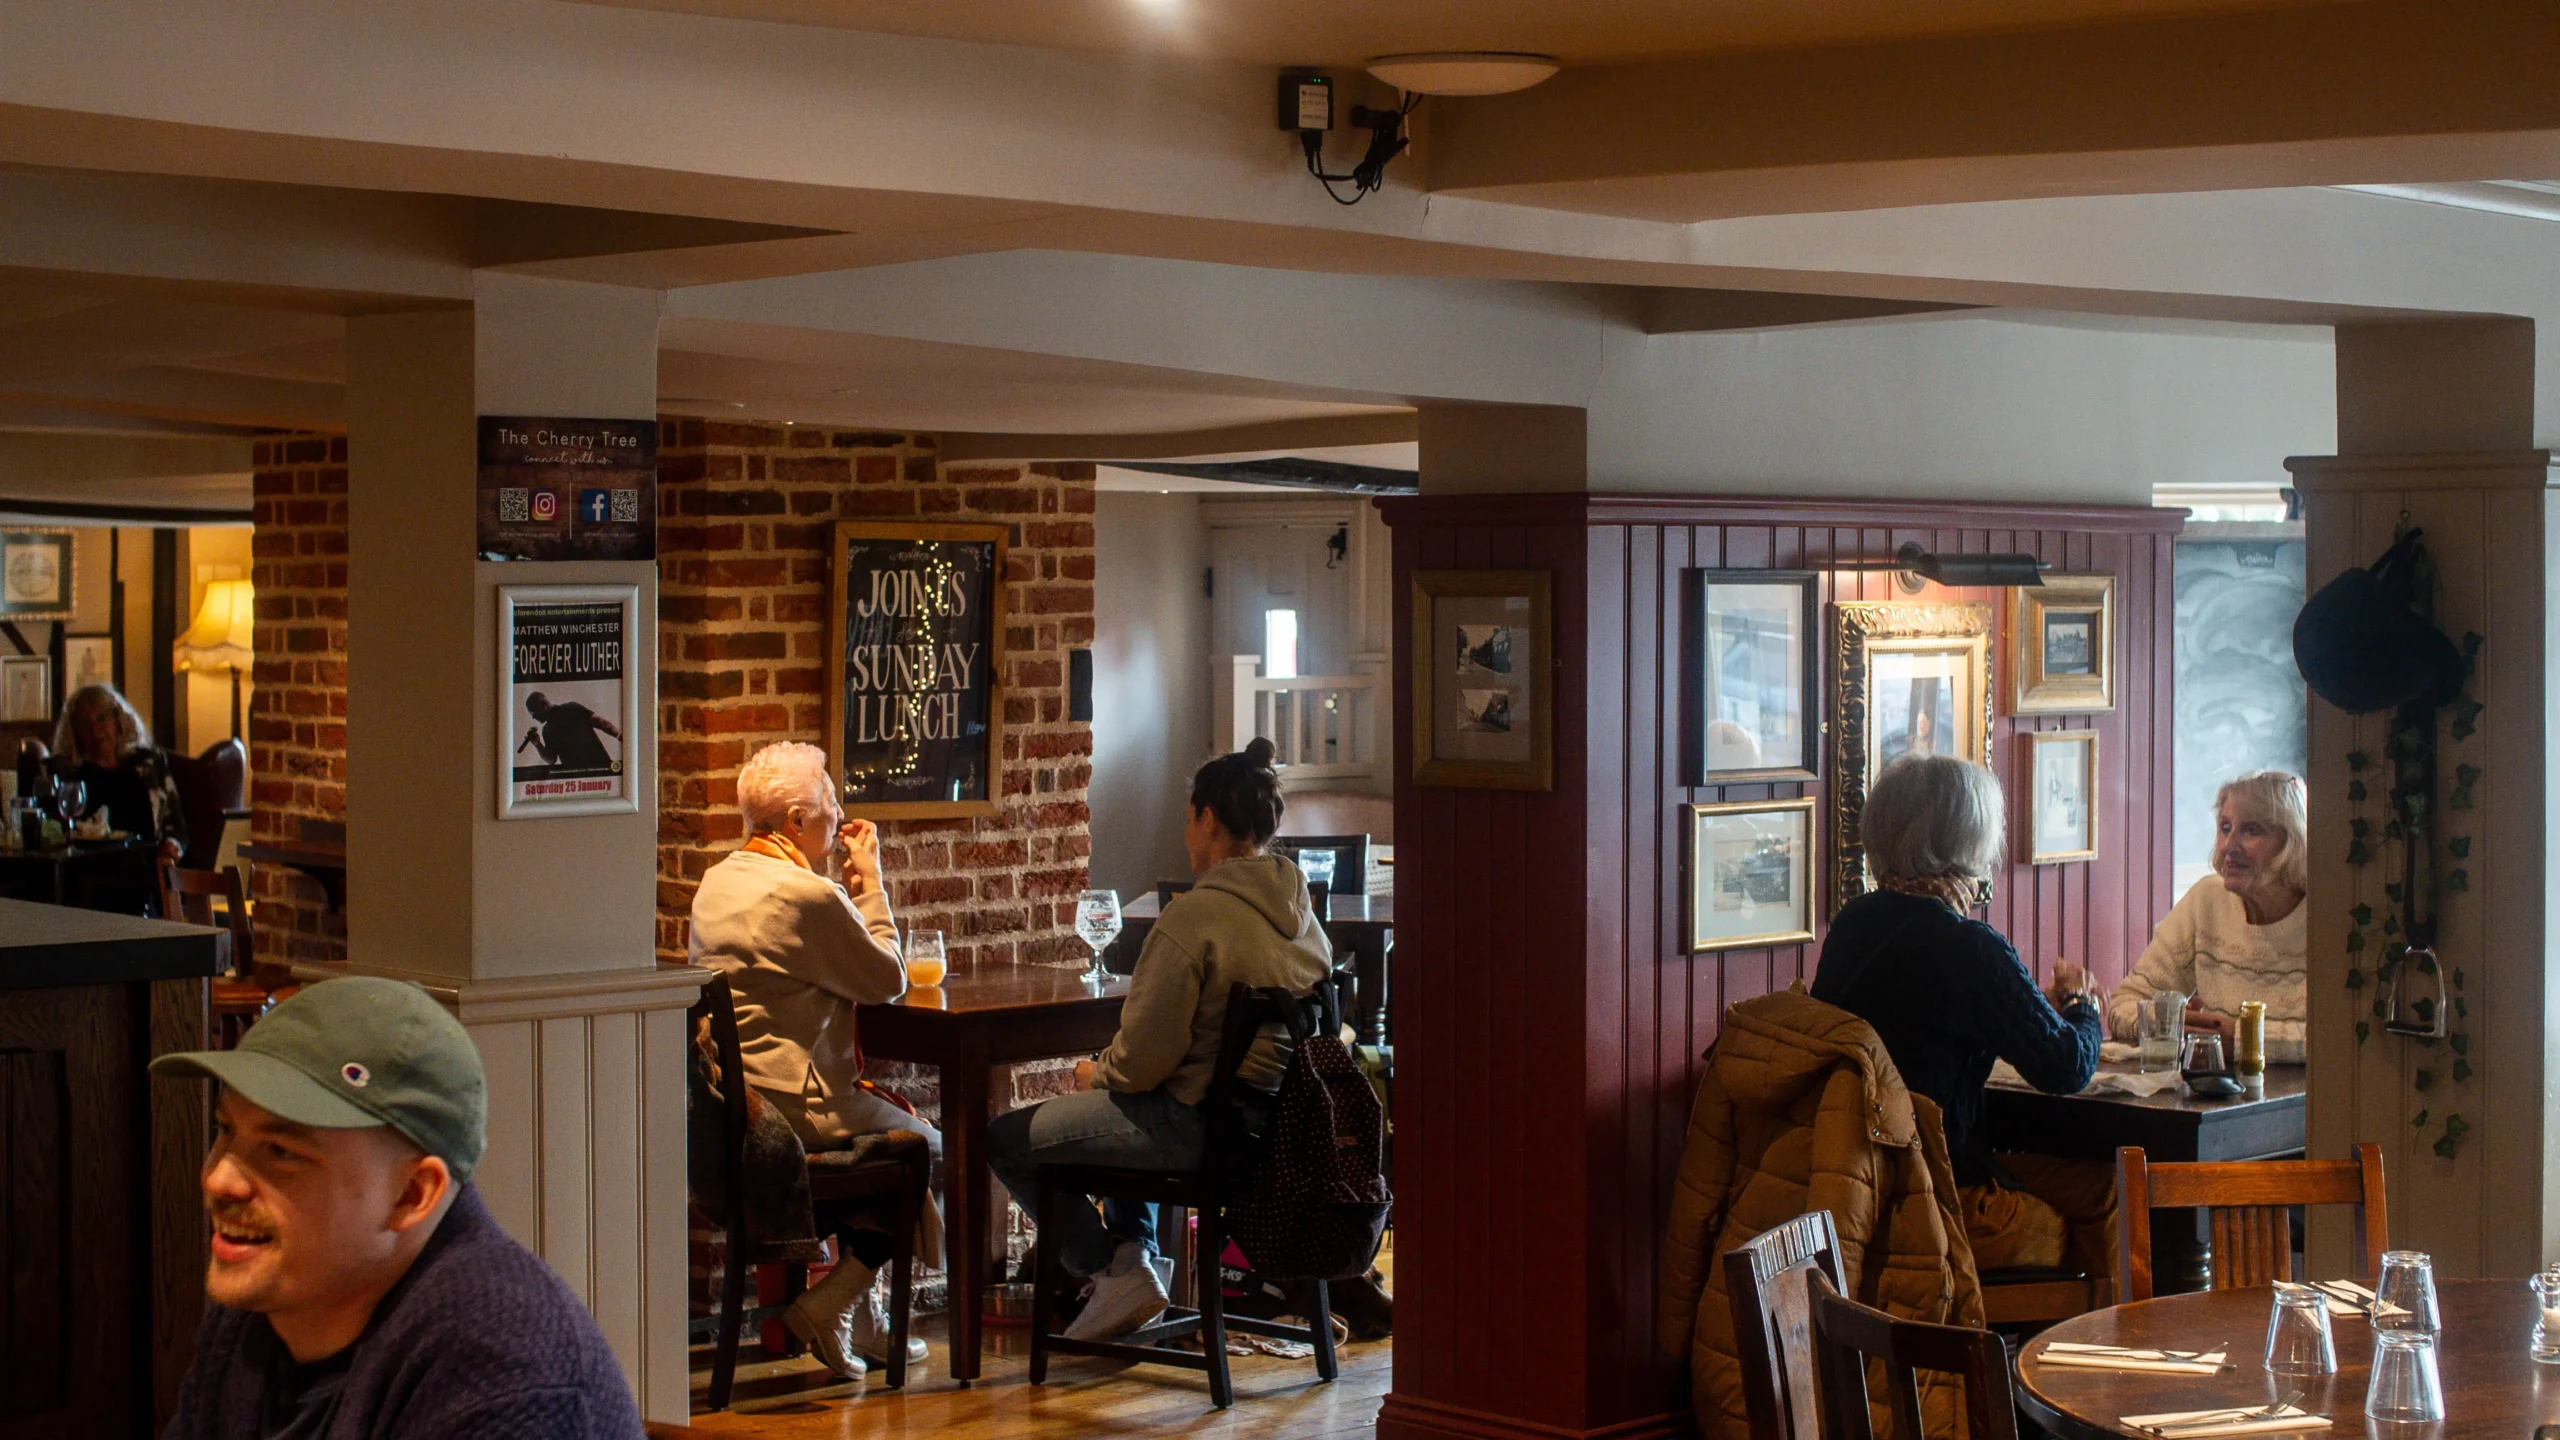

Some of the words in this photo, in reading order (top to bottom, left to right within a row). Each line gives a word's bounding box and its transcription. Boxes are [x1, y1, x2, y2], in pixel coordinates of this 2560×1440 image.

[499, 429, 529, 445] The
[537, 430, 595, 449] Cherry
[602, 431, 638, 448] Tree
[524, 451, 567, 464] connect
[569, 451, 596, 465] with
[857, 569, 929, 618] JOIN
[937, 569, 966, 618] US
[513, 624, 558, 636] MATTHEW
[561, 622, 620, 634] WINCHESTER
[513, 643, 572, 676] FOREVER
[575, 641, 620, 673] LUTHER
[852, 643, 979, 692] SUNDAY
[857, 692, 960, 743] LUNCH
[525, 782, 564, 796] Saturday
[565, 781, 576, 793] 25
[578, 779, 612, 792] January
